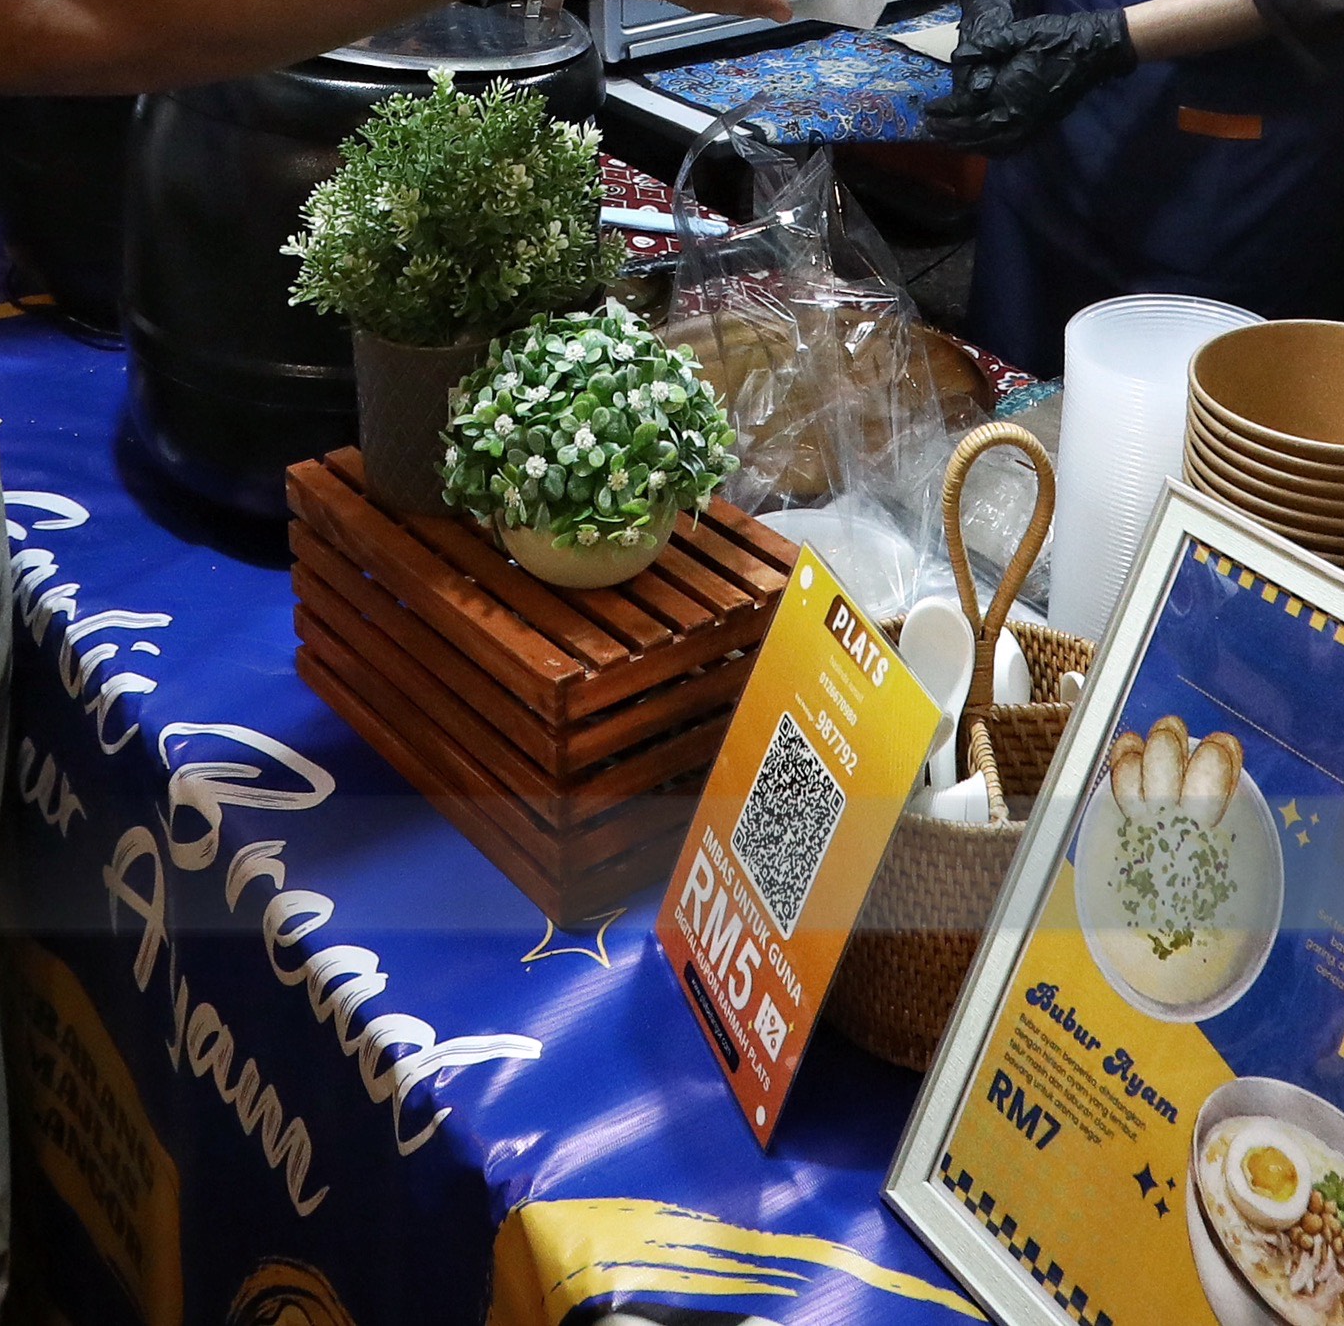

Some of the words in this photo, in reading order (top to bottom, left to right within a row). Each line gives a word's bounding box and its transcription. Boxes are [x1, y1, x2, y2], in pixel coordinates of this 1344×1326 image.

[832, 604, 889, 688] PLATS
[816, 710, 859, 777] 987792
[159, 722, 542, 1156] Bread
[680, 847, 762, 1011] RM5
[702, 825, 735, 886] IMBAS
[733, 879, 771, 950] UNTUK
[769, 943, 802, 1007] GUNA
[674, 905, 696, 954] DIGITAL
[696, 949, 719, 996] KUPON
[718, 990, 748, 1052] RAHMAH
[747, 1046, 771, 1092] PLATS
[1025, 982, 1101, 1051] Bubur
[1103, 1048, 1179, 1125] Ayam
[986, 1068, 1062, 1151] RM7
